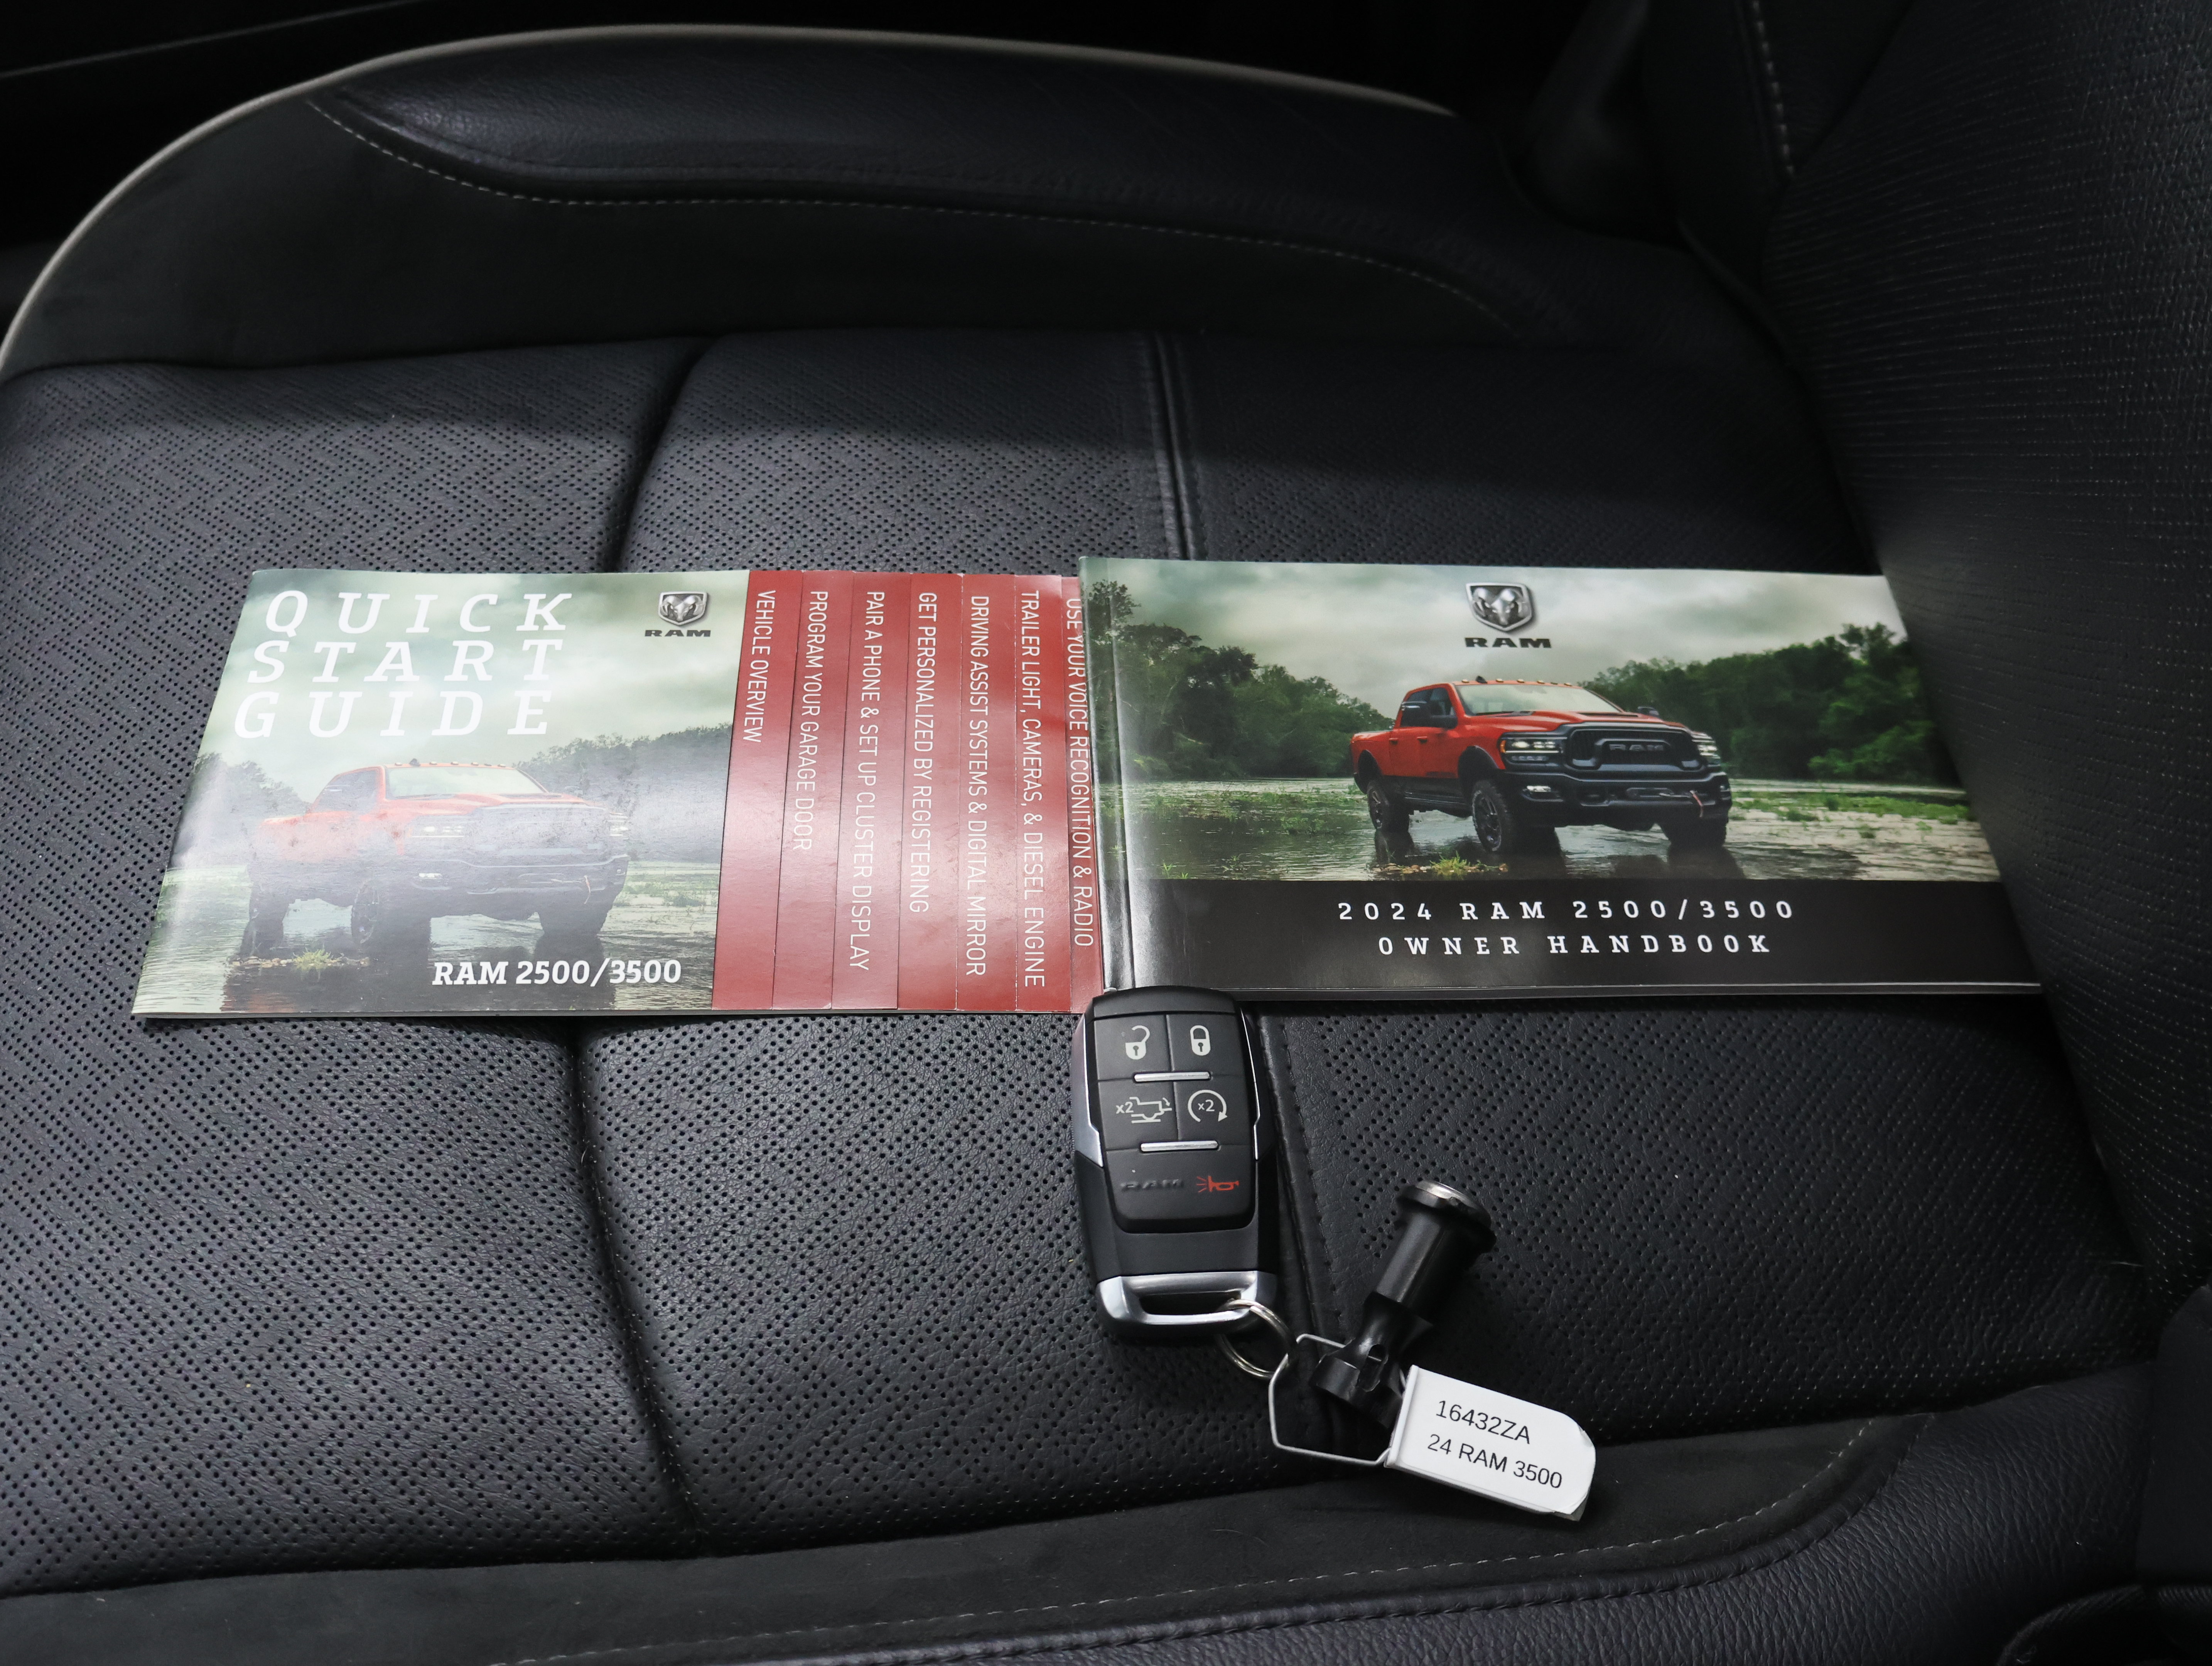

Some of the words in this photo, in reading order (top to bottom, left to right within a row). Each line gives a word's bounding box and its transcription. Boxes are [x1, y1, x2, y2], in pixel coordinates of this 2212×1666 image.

[265, 590, 572, 637] QUICK
[752, 590, 776, 655] VEHICLE
[805, 591, 828, 668] PROGRAM
[865, 592, 885, 626] PAIR
[918, 592, 937, 622] GET
[970, 596, 989, 658] DRIVING
[1021, 590, 1040, 656] TRAILER
[1066, 599, 1083, 629] USE
[864, 630, 883, 640] A
[1067, 635, 1085, 677] YOUR
[1465, 637, 1552, 648] RAM
[247, 639, 563, 683] START
[861, 645, 882, 701] PHONE
[743, 659, 769, 743] OVERVIEW
[801, 673, 823, 716] YOUR
[914, 626, 936, 752] PERSONALIZED
[970, 661, 989, 716] ASSIST
[1021, 662, 1041, 713] LIGHT,
[1068, 682, 1088, 730] VOICE
[234, 690, 552, 739] GUIDE
[861, 707, 879, 718] &
[796, 721, 819, 792] GARAGE
[859, 725, 879, 757] SET
[968, 720, 988, 797] SYSTEMS
[1021, 719, 1042, 806] CAMERAS,
[857, 762, 877, 786] UP
[913, 759, 933, 780] BY
[968, 802, 987, 814] &
[1023, 813, 1042, 825] &
[1070, 737, 1091, 858] RECOGNITION
[793, 798, 815, 850] DOOR
[853, 792, 876, 877] CLUSTER
[909, 786, 931, 913] REGISTERING
[967, 821, 987, 890] DIGITAL
[1024, 833, 1043, 900] DIESEL
[1073, 865, 1092, 878] &
[850, 886, 872, 971] DISPLAY
[1073, 886, 1093, 946] RADIO
[1338, 903, 1431, 920] 2024
[1459, 902, 1545, 920] RAM
[1573, 899, 1792, 920] 2500/3500
[966, 897, 986, 975] MIRROR
[1024, 907, 1044, 987] ENGINE
[1378, 937, 1519, 955] OWNER
[1547, 934, 1770, 954] HANDBOOK
[432, 961, 508, 985] RAM
[516, 958, 682, 987] 2500/3500
[1116, 1101, 1134, 1114] x2
[1198, 1099, 1215, 1112] x2
[1436, 1400, 1530, 1444] 16432ZA
[1427, 1434, 1451, 1455] 24
[1459, 1443, 1508, 1472] RAM
[1513, 1460, 1562, 1488] 3500
